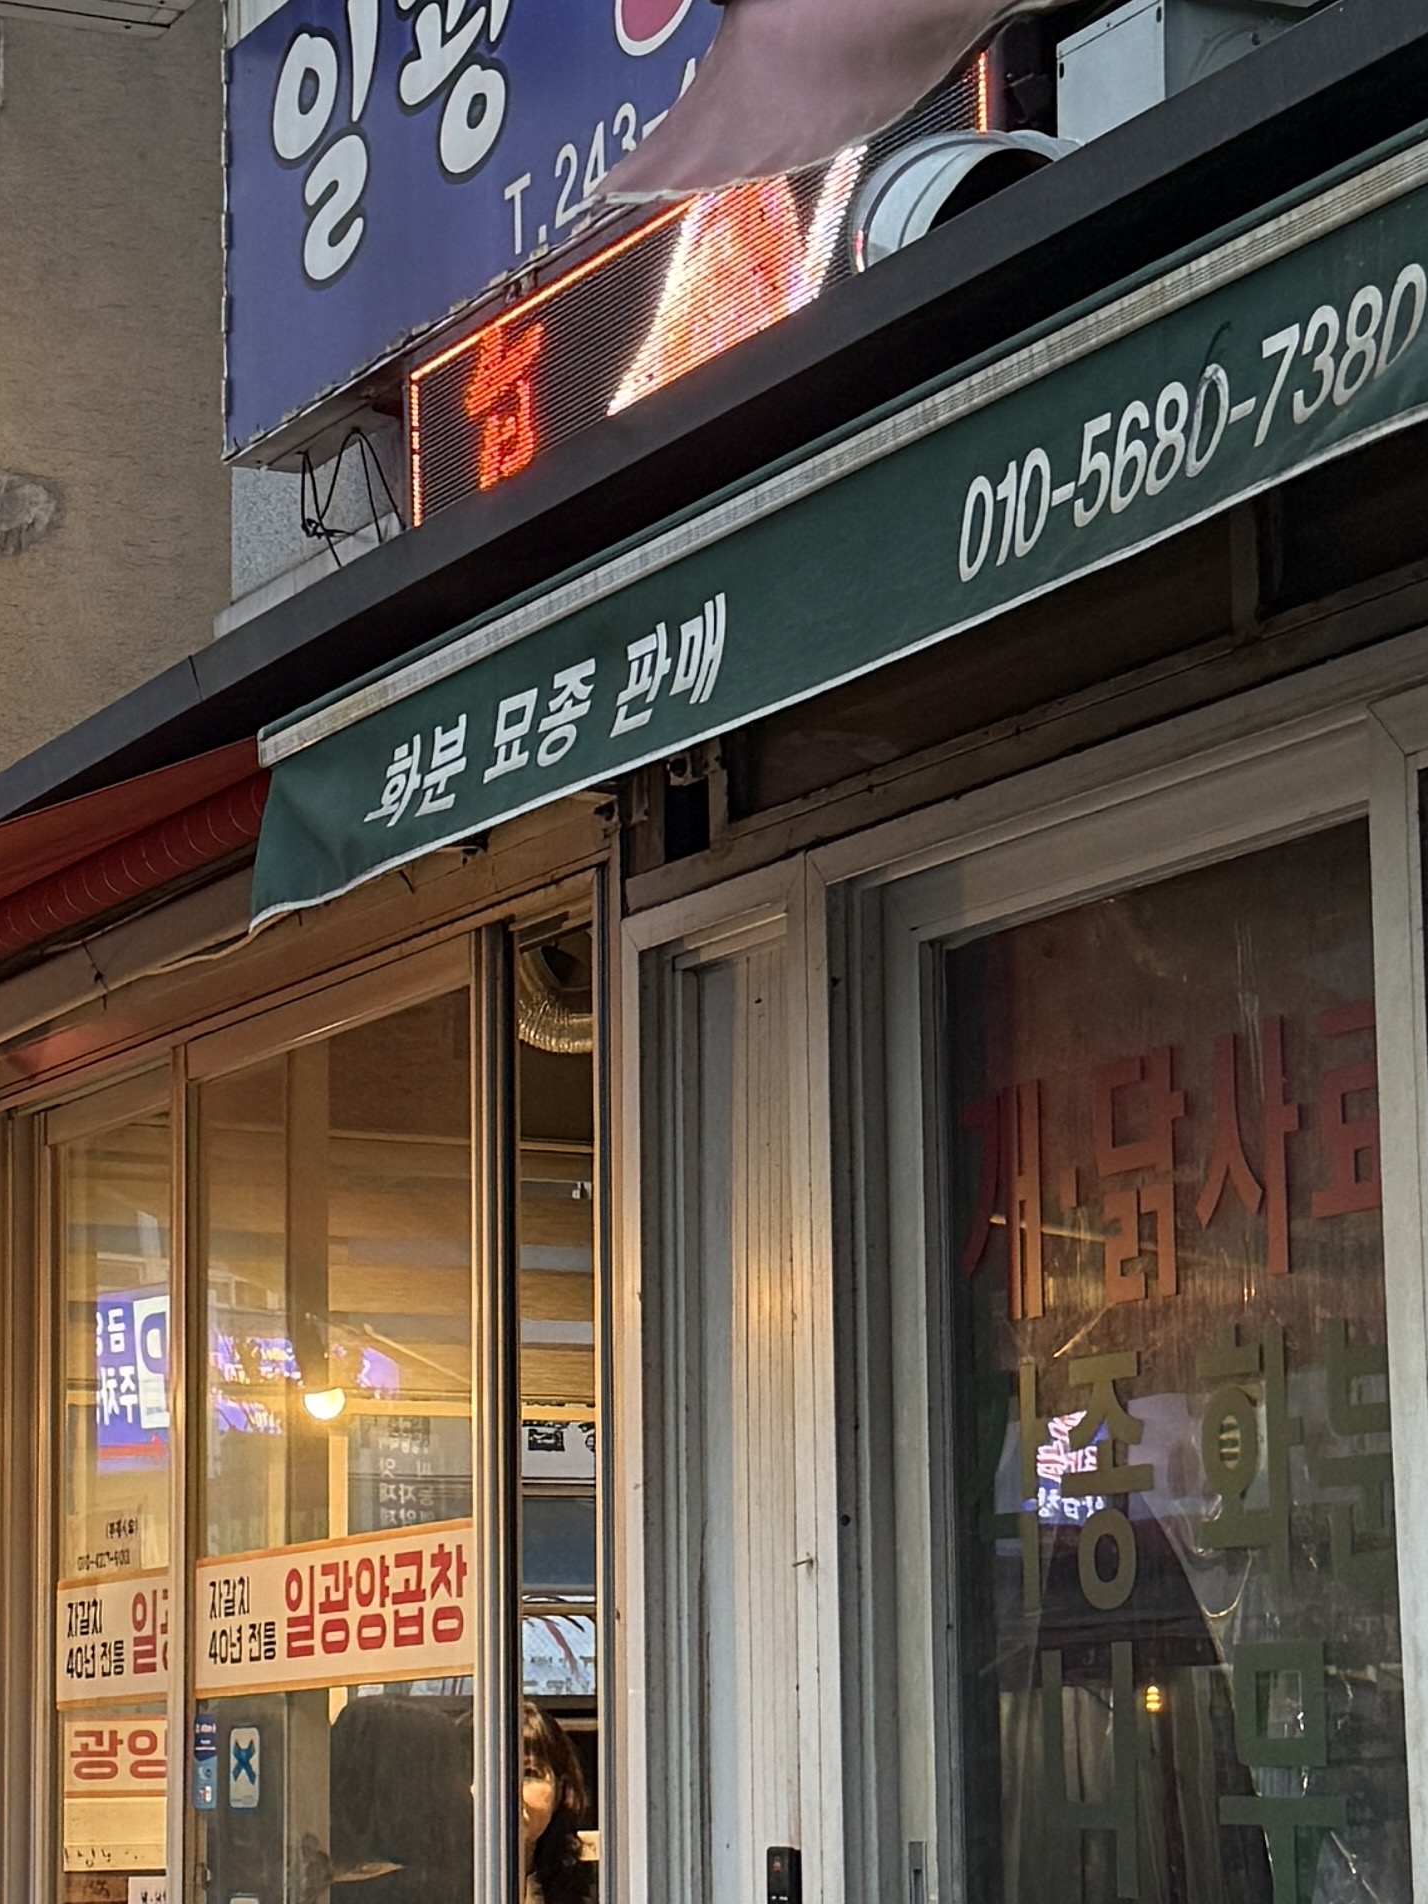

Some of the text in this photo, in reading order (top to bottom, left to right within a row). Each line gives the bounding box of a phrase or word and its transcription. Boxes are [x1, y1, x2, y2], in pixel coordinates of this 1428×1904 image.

[363, 591, 727, 830] 화분 묘종 판매
[66, 1597, 104, 1639] 자갈치
[208, 1574, 251, 1621] 자갈치
[284, 1542, 468, 1660] 일광양곱창
[130, 1588, 168, 1676] 일
[207, 1619, 278, 1666] 40년 전통
[65, 1639, 126, 1680] 40년 전통
